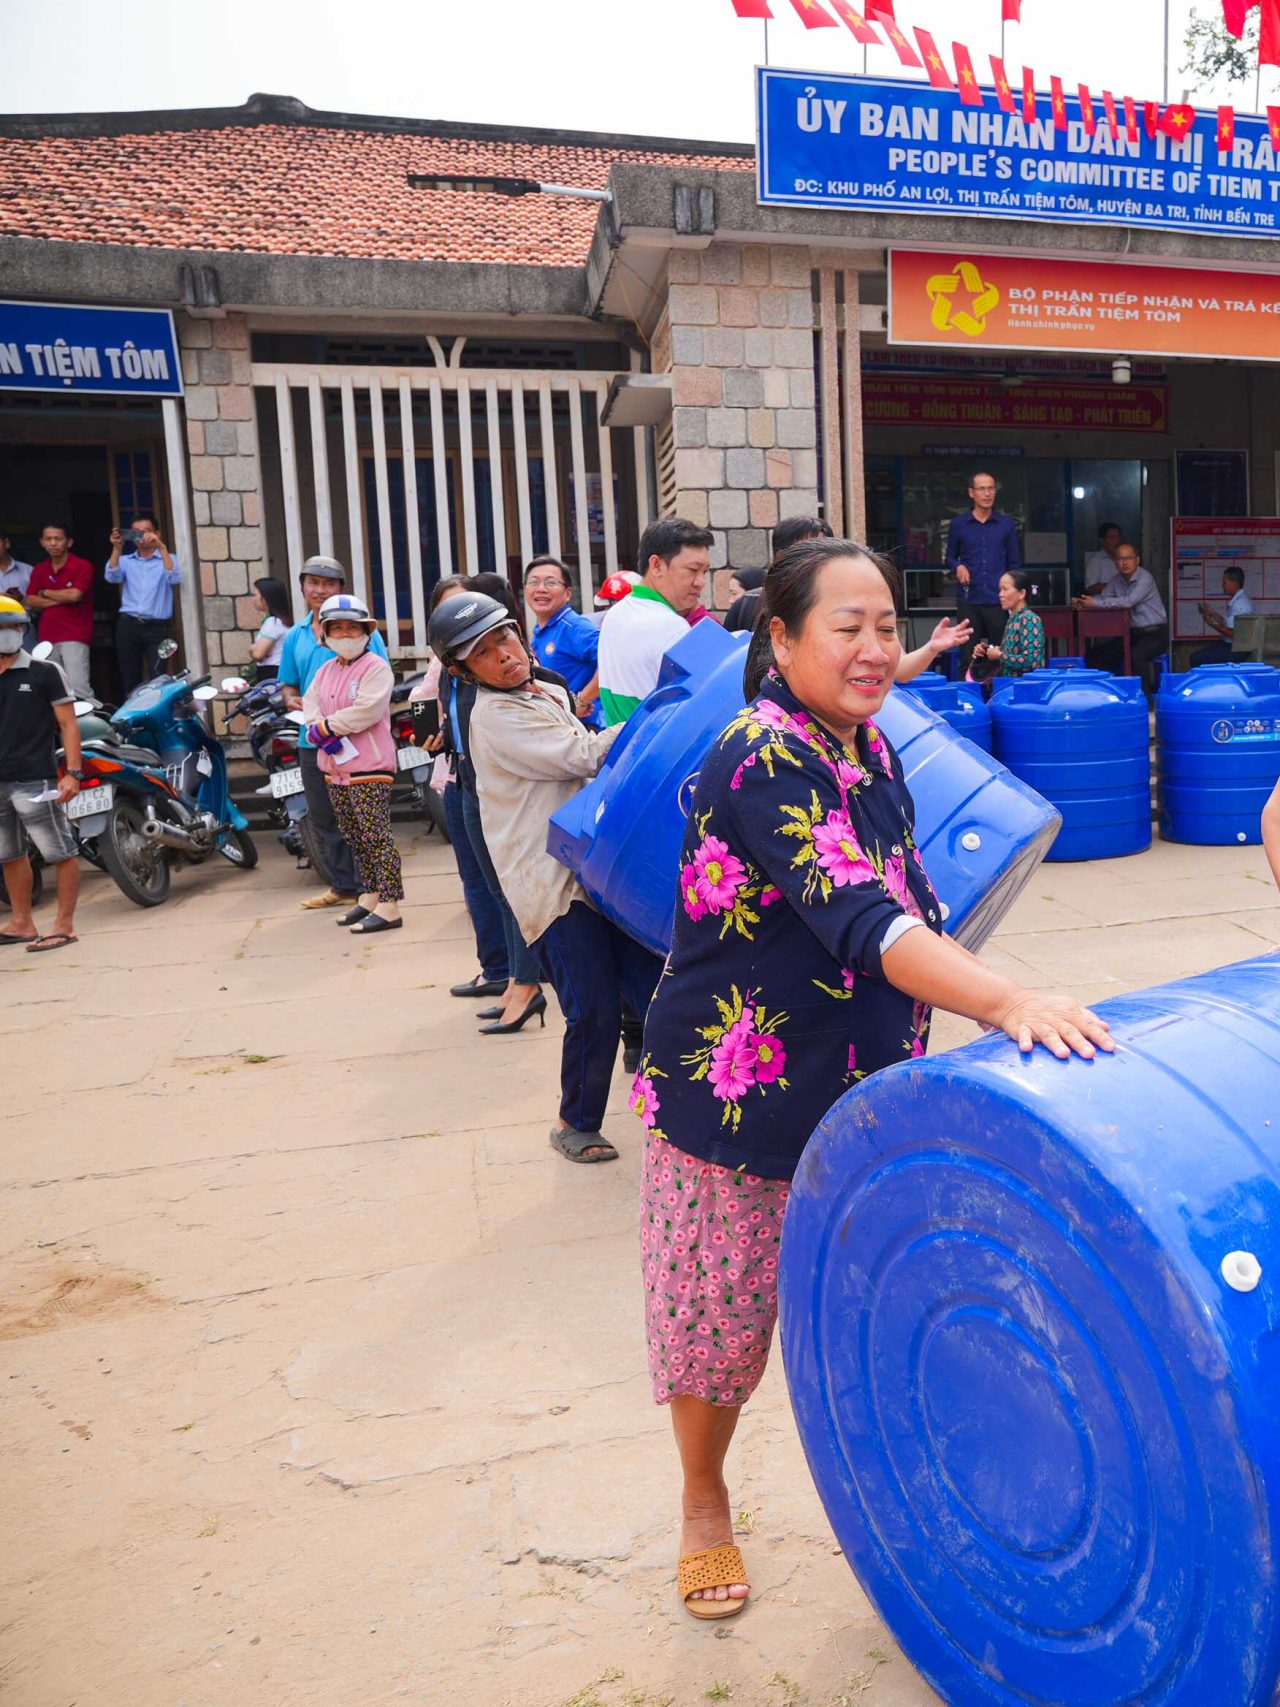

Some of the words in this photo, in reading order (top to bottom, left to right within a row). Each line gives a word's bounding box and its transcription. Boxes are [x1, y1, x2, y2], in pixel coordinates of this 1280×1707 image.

[796, 86, 847, 134] ỦY
[859, 102, 939, 141] BAN
[951, 108, 1055, 151] NHÂN
[1067, 117, 1141, 158] DÂN
[1155, 130, 1204, 171] THỊ
[888, 147, 1013, 180] PEOPLE'S
[1020, 157, 1165, 191] COMMITTEE
[1172, 171, 1201, 194] OF
[1206, 174, 1262, 200] TIEM
[794, 179, 823, 193] ĐC:
[827, 181, 859, 196] KHU
[863, 180, 897, 197] PHỐ
[900, 185, 922, 199] AN
[926, 187, 954, 205] LỢI,
[957, 189, 980, 207] THỊ
[983, 187, 1020, 207] TRẤN
[1023, 191, 1056, 212] TIỆM
[1059, 194, 1094, 214] TÔM,
[1097, 199, 1142, 217] HUYỆN
[1145, 203, 1164, 217] BA
[1167, 205, 1190, 221] TRI,
[1194, 204, 1222, 222] TỈNH
[1225, 206, 1251, 224] BẾN
[1254, 212, 1275, 226] TRE
[1008, 287, 1037, 302] BỘ
[1042, 289, 1094, 304] PHẬN
[1098, 291, 1138, 305] TIẾP
[1143, 294, 1193, 310] NHẬN
[1198, 297, 1221, 311] VÀ
[1223, 299, 1256, 313] TRẢ
[1008, 303, 1039, 318] THỊ
[1044, 303, 1092, 318] TRẤN
[1097, 306, 1139, 322] TIỆM
[1143, 309, 1181, 323] TÔM
[25, 338, 101, 386] TIỆM
[105, 340, 170, 381] TÔM
[277, 770, 300, 784] 71-C
